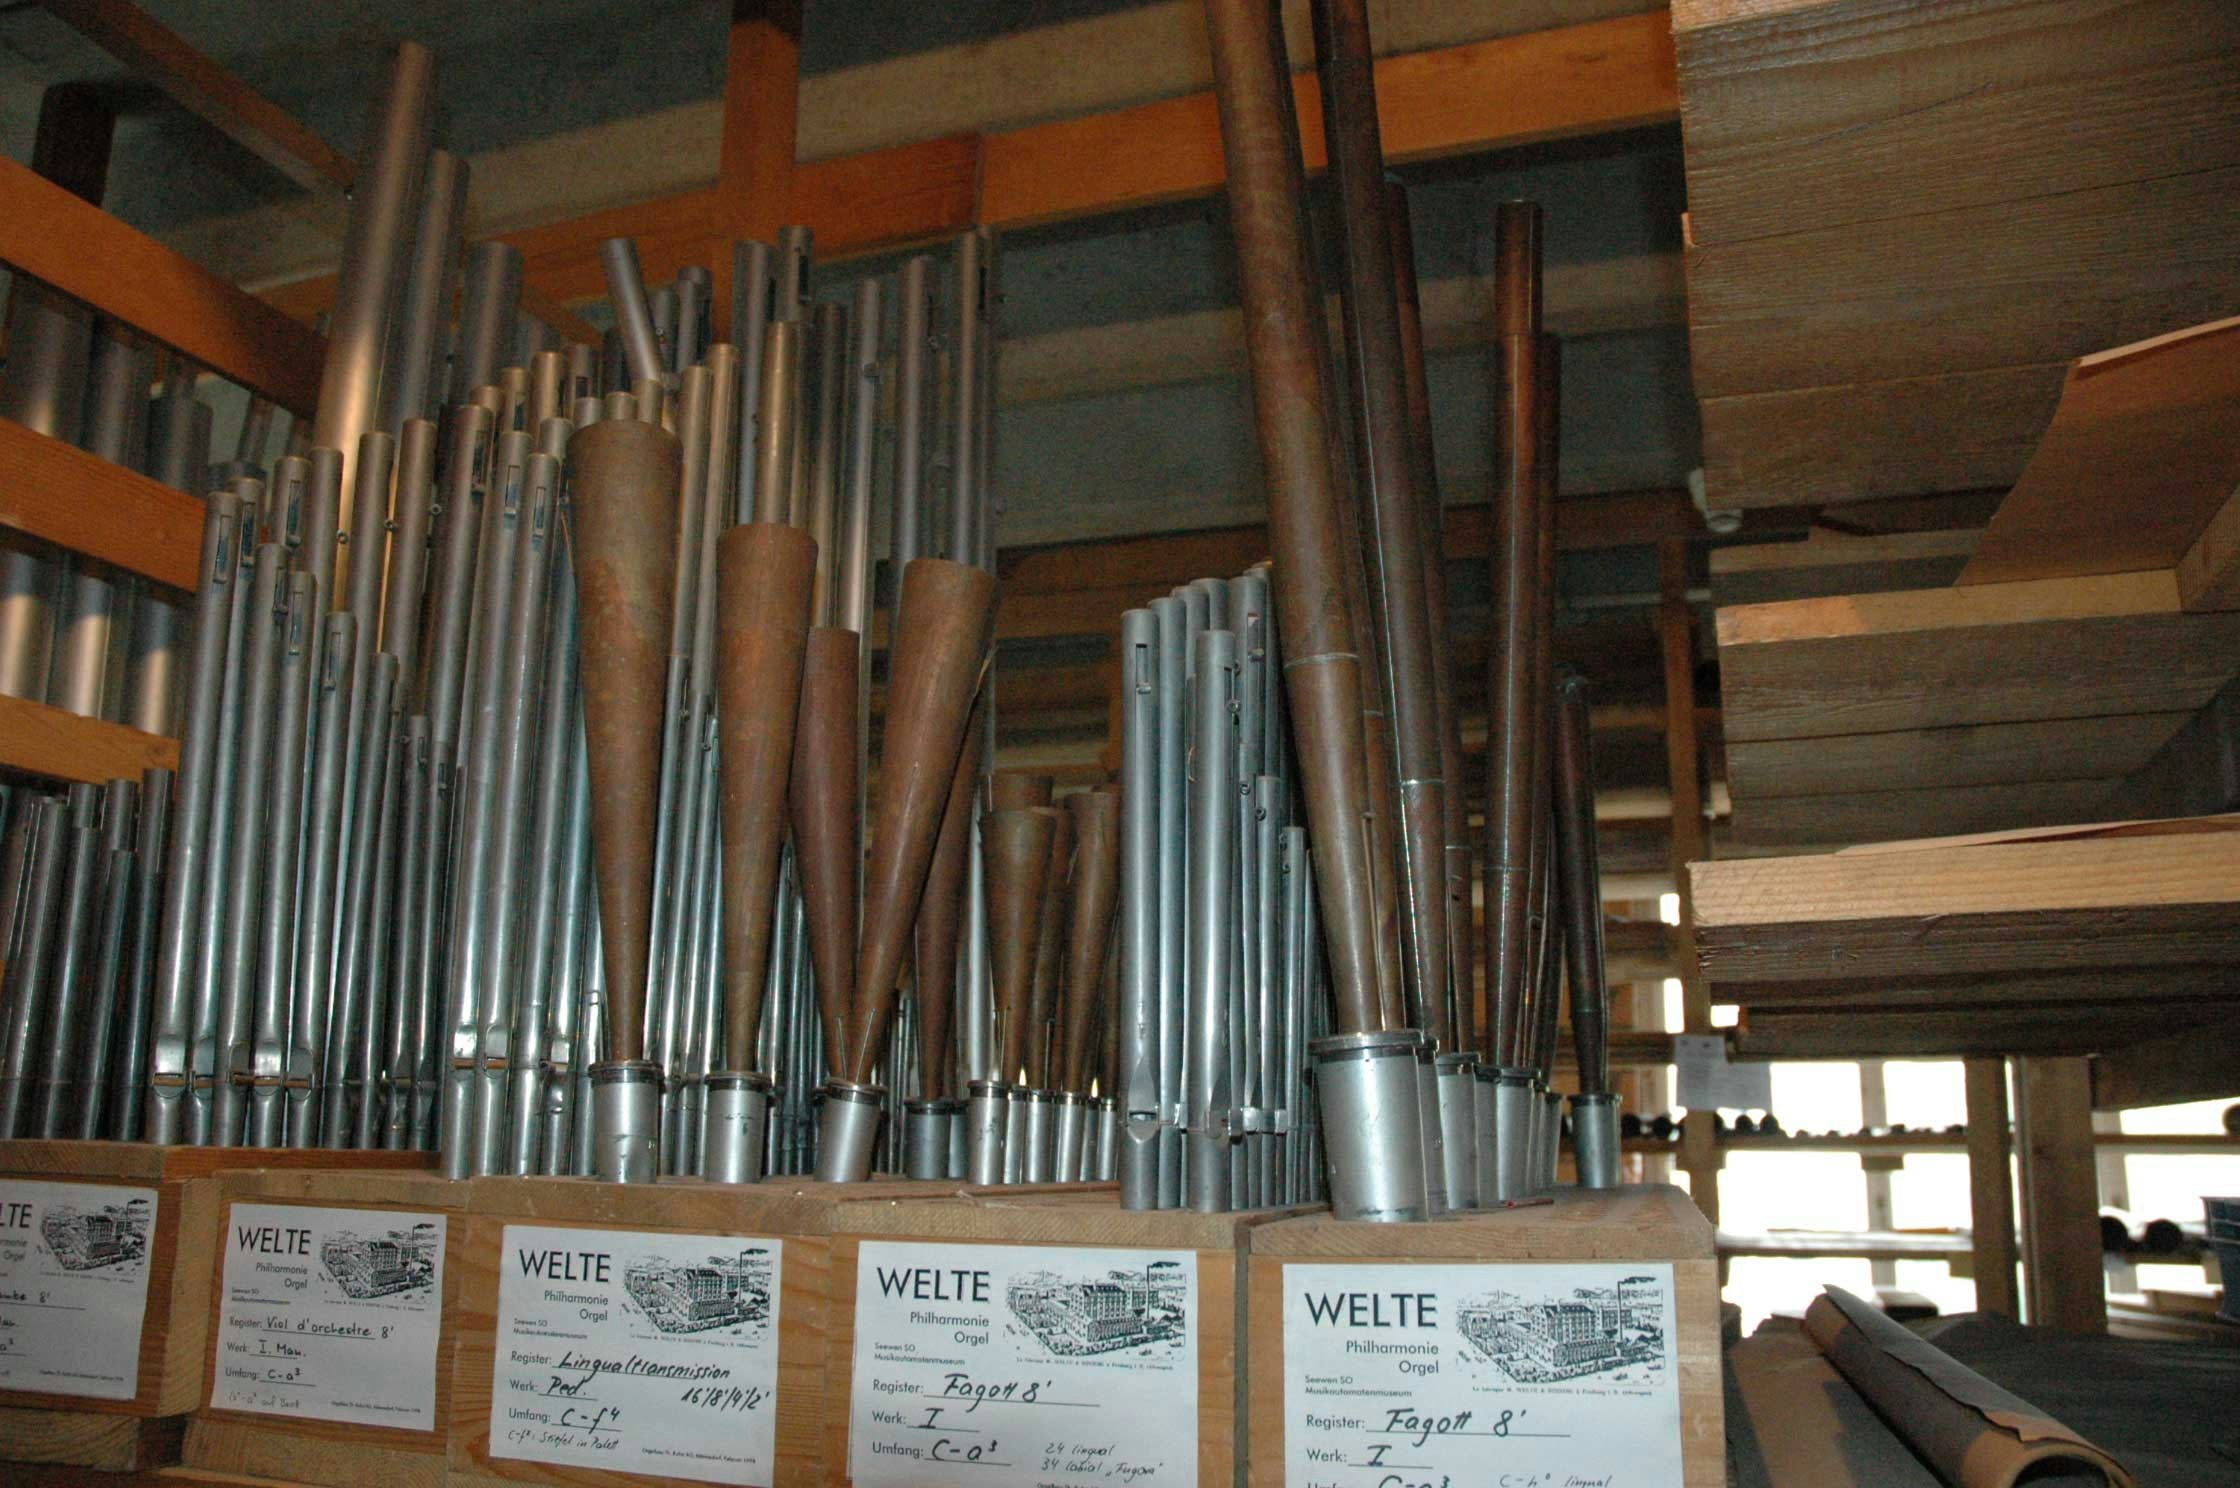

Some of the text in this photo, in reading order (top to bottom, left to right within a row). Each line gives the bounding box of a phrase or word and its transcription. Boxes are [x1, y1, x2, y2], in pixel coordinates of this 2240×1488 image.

[238, 1226, 312, 1255] WELTE
[256, 1262, 308, 1275] Philharmonie
[519, 1249, 611, 1282] WELTE
[284, 1278, 308, 1290] Orgel
[876, 1267, 990, 1302] WELTE
[544, 1290, 609, 1305] Philharmonie
[579, 1308, 608, 1323] Orgel
[1304, 1293, 1439, 1328] WELTE
[910, 1311, 990, 1328] Philharmonie
[229, 1316, 263, 1329] Register:
[266, 1316, 288, 1330] Viol
[381, 1325, 395, 1340] 8'
[954, 1331, 989, 1347] Orgel
[226, 1342, 250, 1353] Werk:
[904, 1344, 916, 1353] SO
[1346, 1340, 1439, 1355] Philharmonie
[511, 1350, 551, 1365] Register:
[225, 1367, 259, 1381] Umfang:
[1399, 1360, 1439, 1376] Orgel
[509, 1378, 538, 1392] Werk:
[1305, 1375, 1353, 1385] Seewen SO
[872, 1373, 1052, 1413] Register: Fagott 8'
[1305, 1386, 1412, 1397] Musikautomatenmuseum
[509, 1407, 551, 1424] Umfang:
[872, 1407, 944, 1429] Werk: I
[1306, 1408, 1527, 1447] Register: Fagott 8'
[872, 1442, 925, 1460] Umfang:
[1306, 1445, 1393, 1467] Werk: I
[1041, 1456, 1060, 1472] 34
